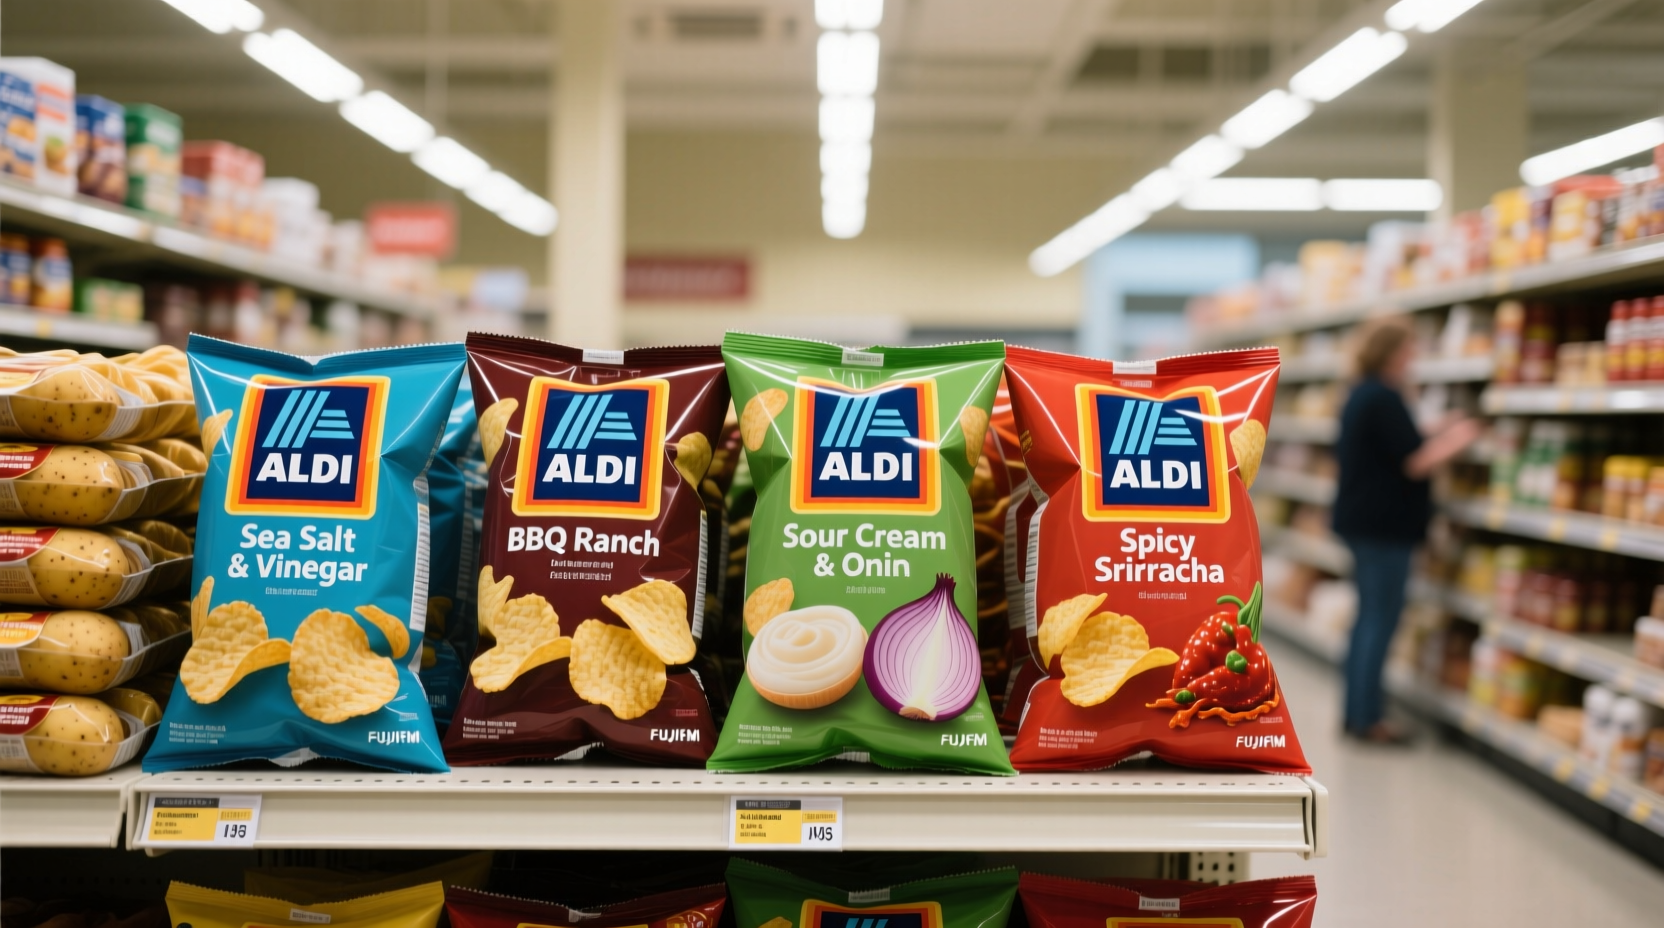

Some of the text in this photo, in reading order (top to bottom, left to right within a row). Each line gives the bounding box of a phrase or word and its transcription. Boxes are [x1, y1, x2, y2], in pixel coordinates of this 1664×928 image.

[256, 452, 353, 484] ALDI
[542, 453, 637, 485] ALDI
[818, 451, 914, 482] ALDI
[1110, 459, 1202, 490] ALDI
[239, 523, 357, 553] Sea Salt
[507, 526, 660, 557] BBQ Ranch
[782, 522, 946, 550] Sour Cream
[1120, 527, 1196, 561] Spicy
[227, 553, 369, 587] & Vinegar
[813, 551, 911, 577] & Onin
[1094, 556, 1225, 584] Srirracha
